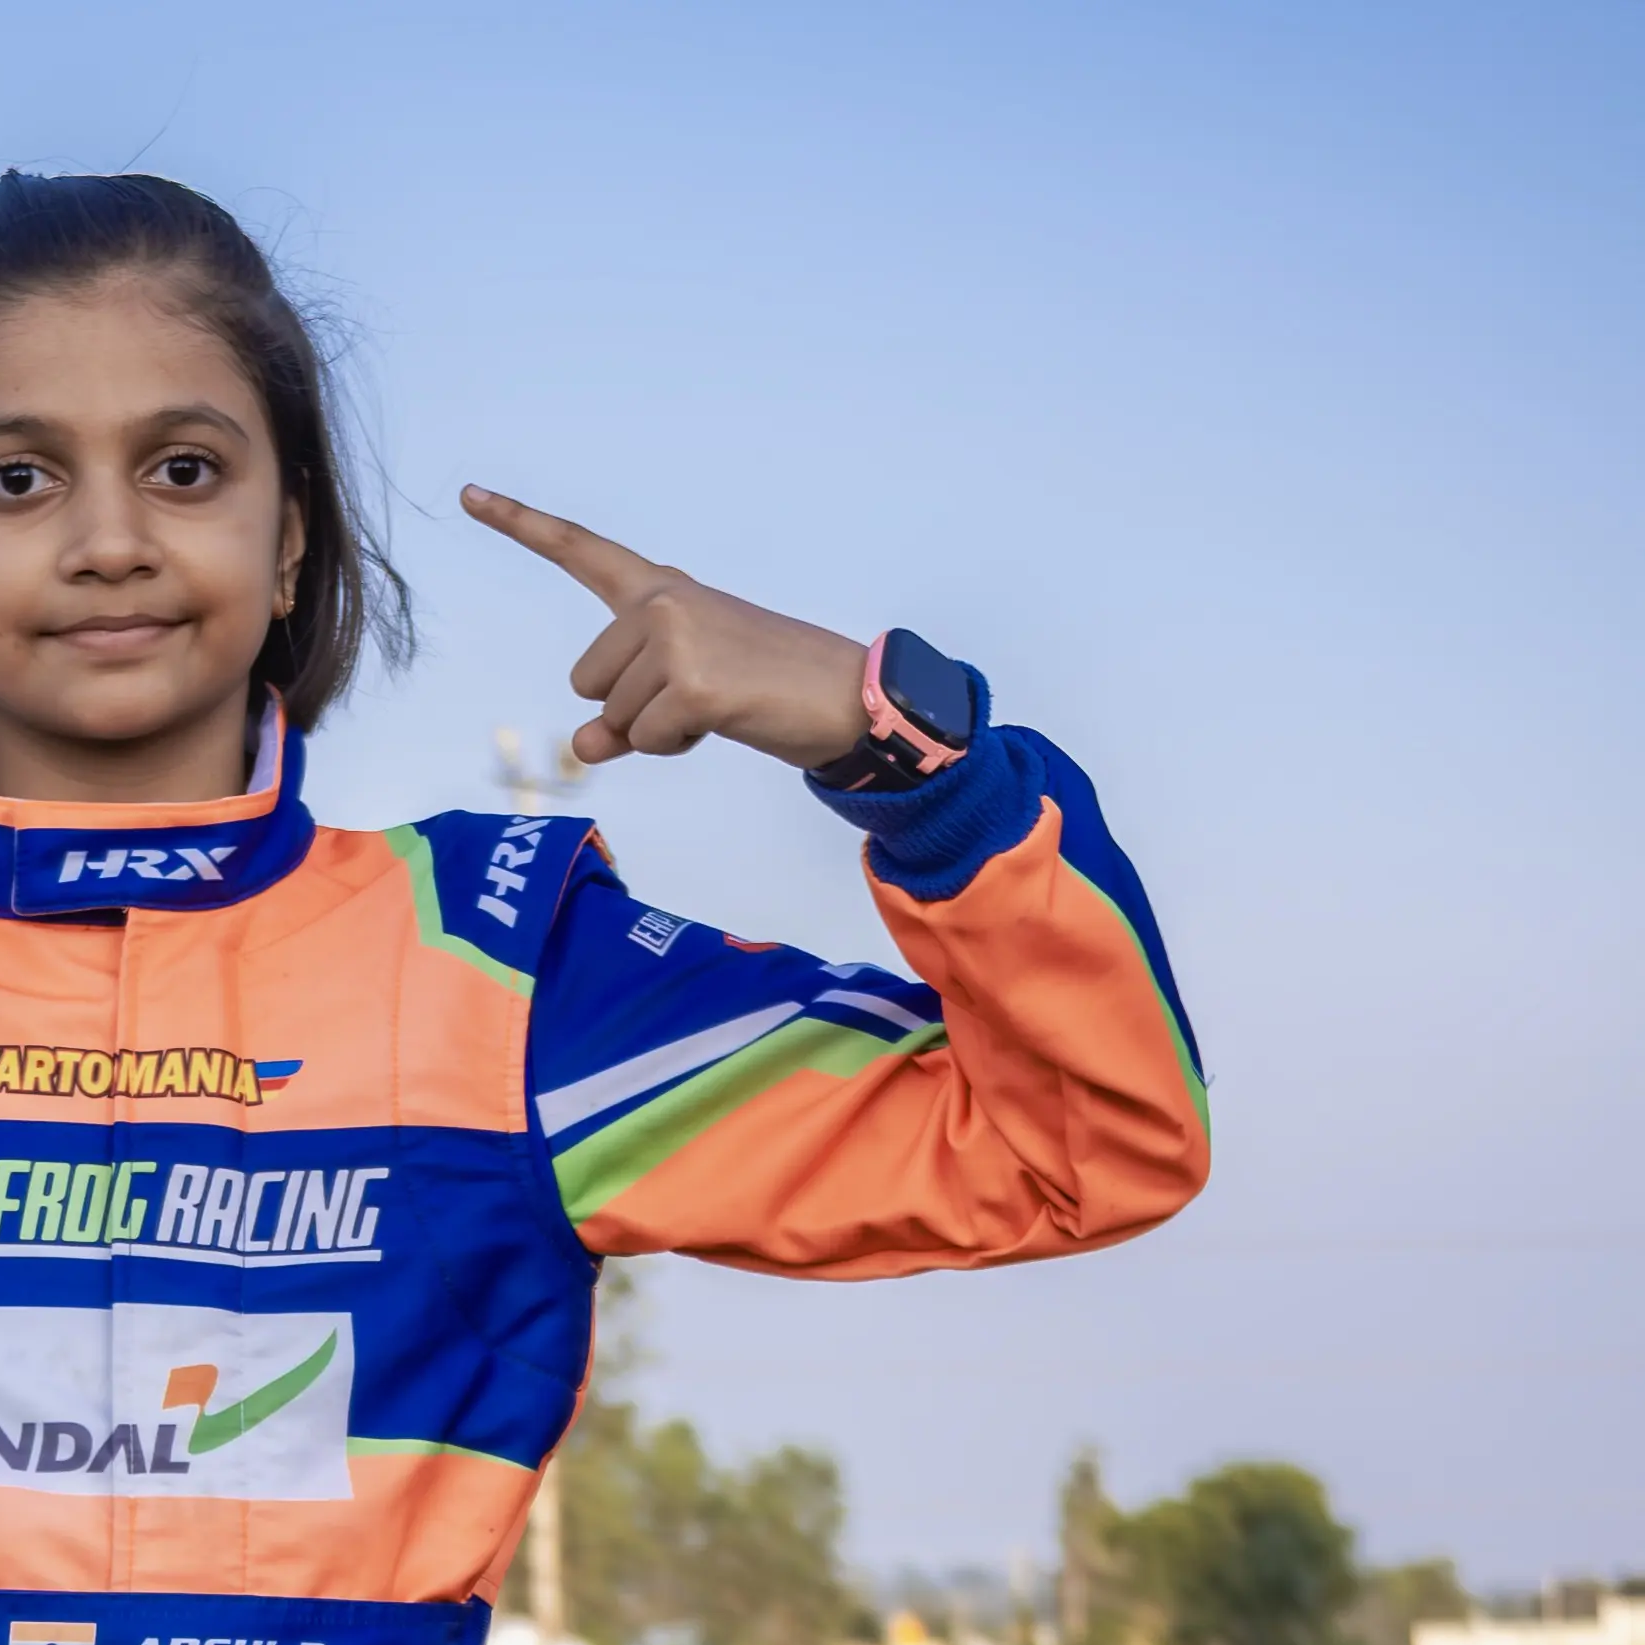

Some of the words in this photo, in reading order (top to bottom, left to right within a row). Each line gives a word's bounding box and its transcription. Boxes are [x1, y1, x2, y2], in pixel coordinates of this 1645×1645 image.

[58, 846, 238, 883] HRX
[477, 815, 553, 929] HRX
[156, 1163, 390, 1252] RACING
